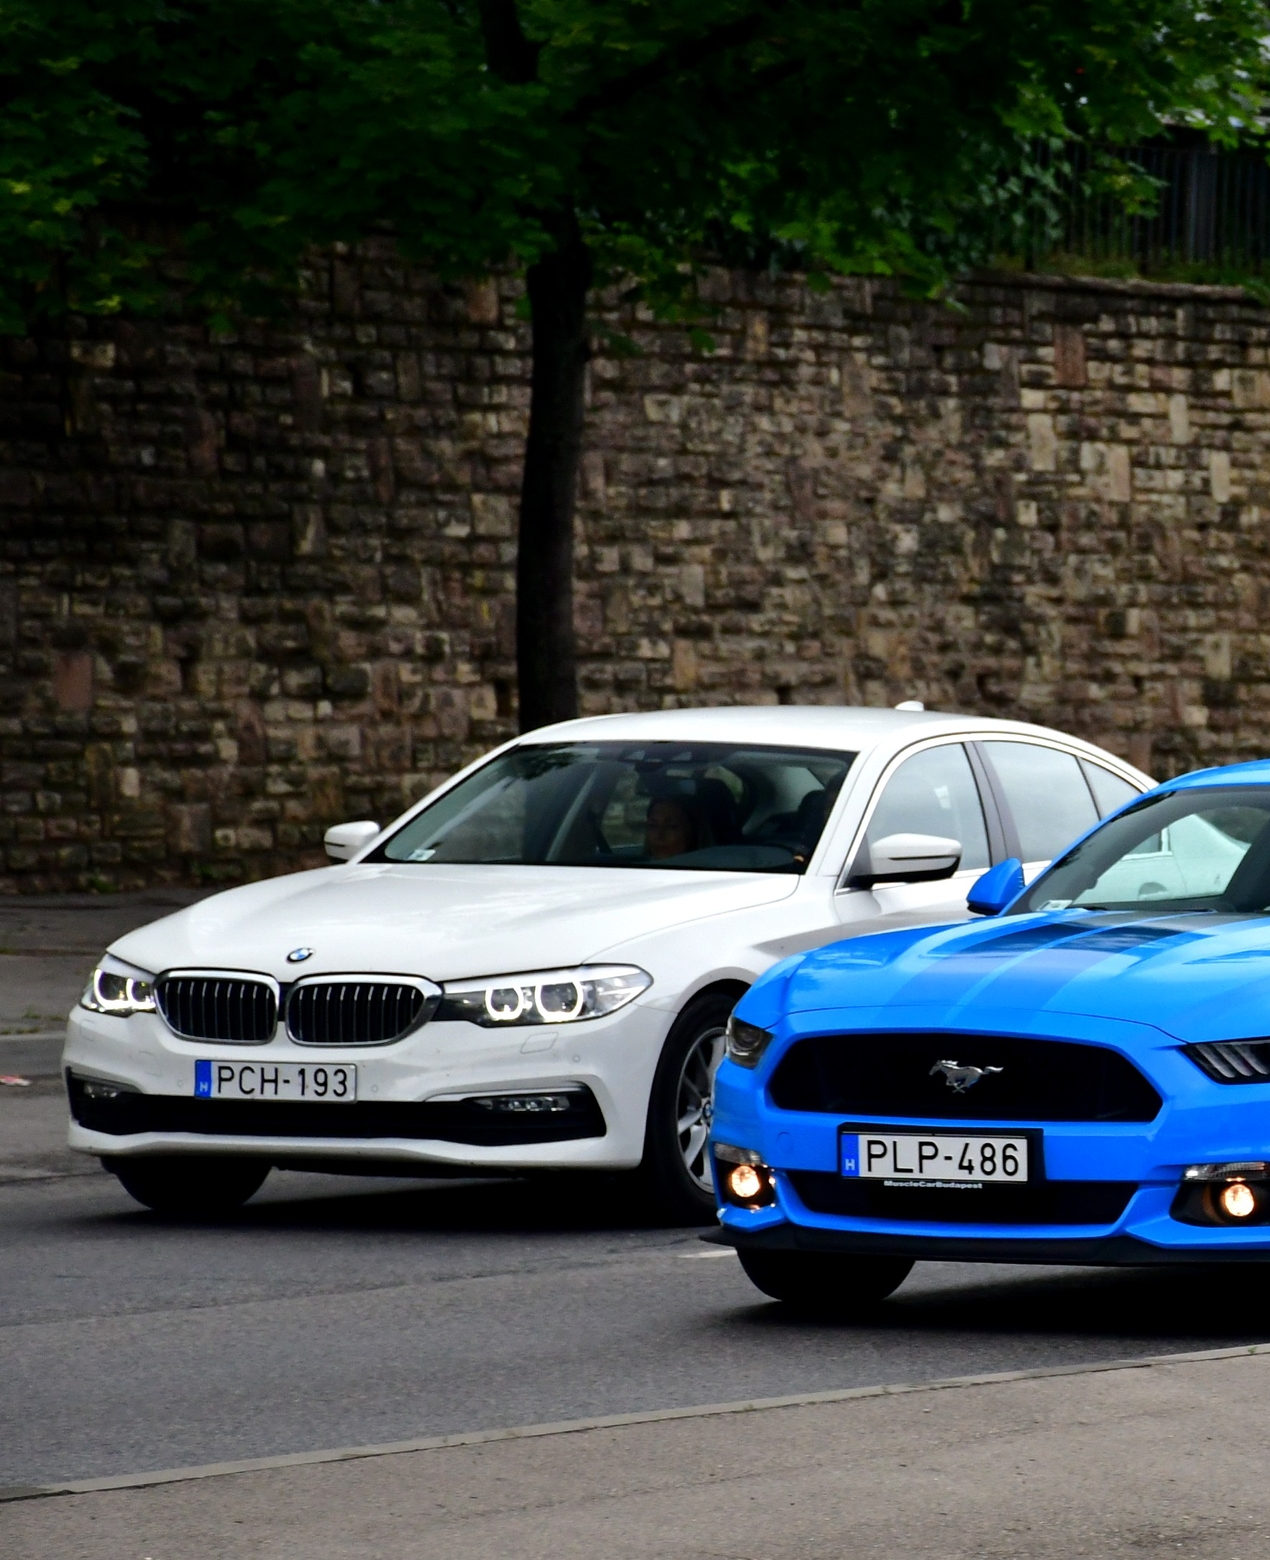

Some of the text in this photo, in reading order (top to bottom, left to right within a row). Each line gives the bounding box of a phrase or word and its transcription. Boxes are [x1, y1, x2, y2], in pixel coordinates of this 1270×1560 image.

[217, 1065, 348, 1097] PCH-193
[845, 1139, 1019, 1177] H PLP-486
[883, 1180, 983, 1189] MuscleCarBudapest
